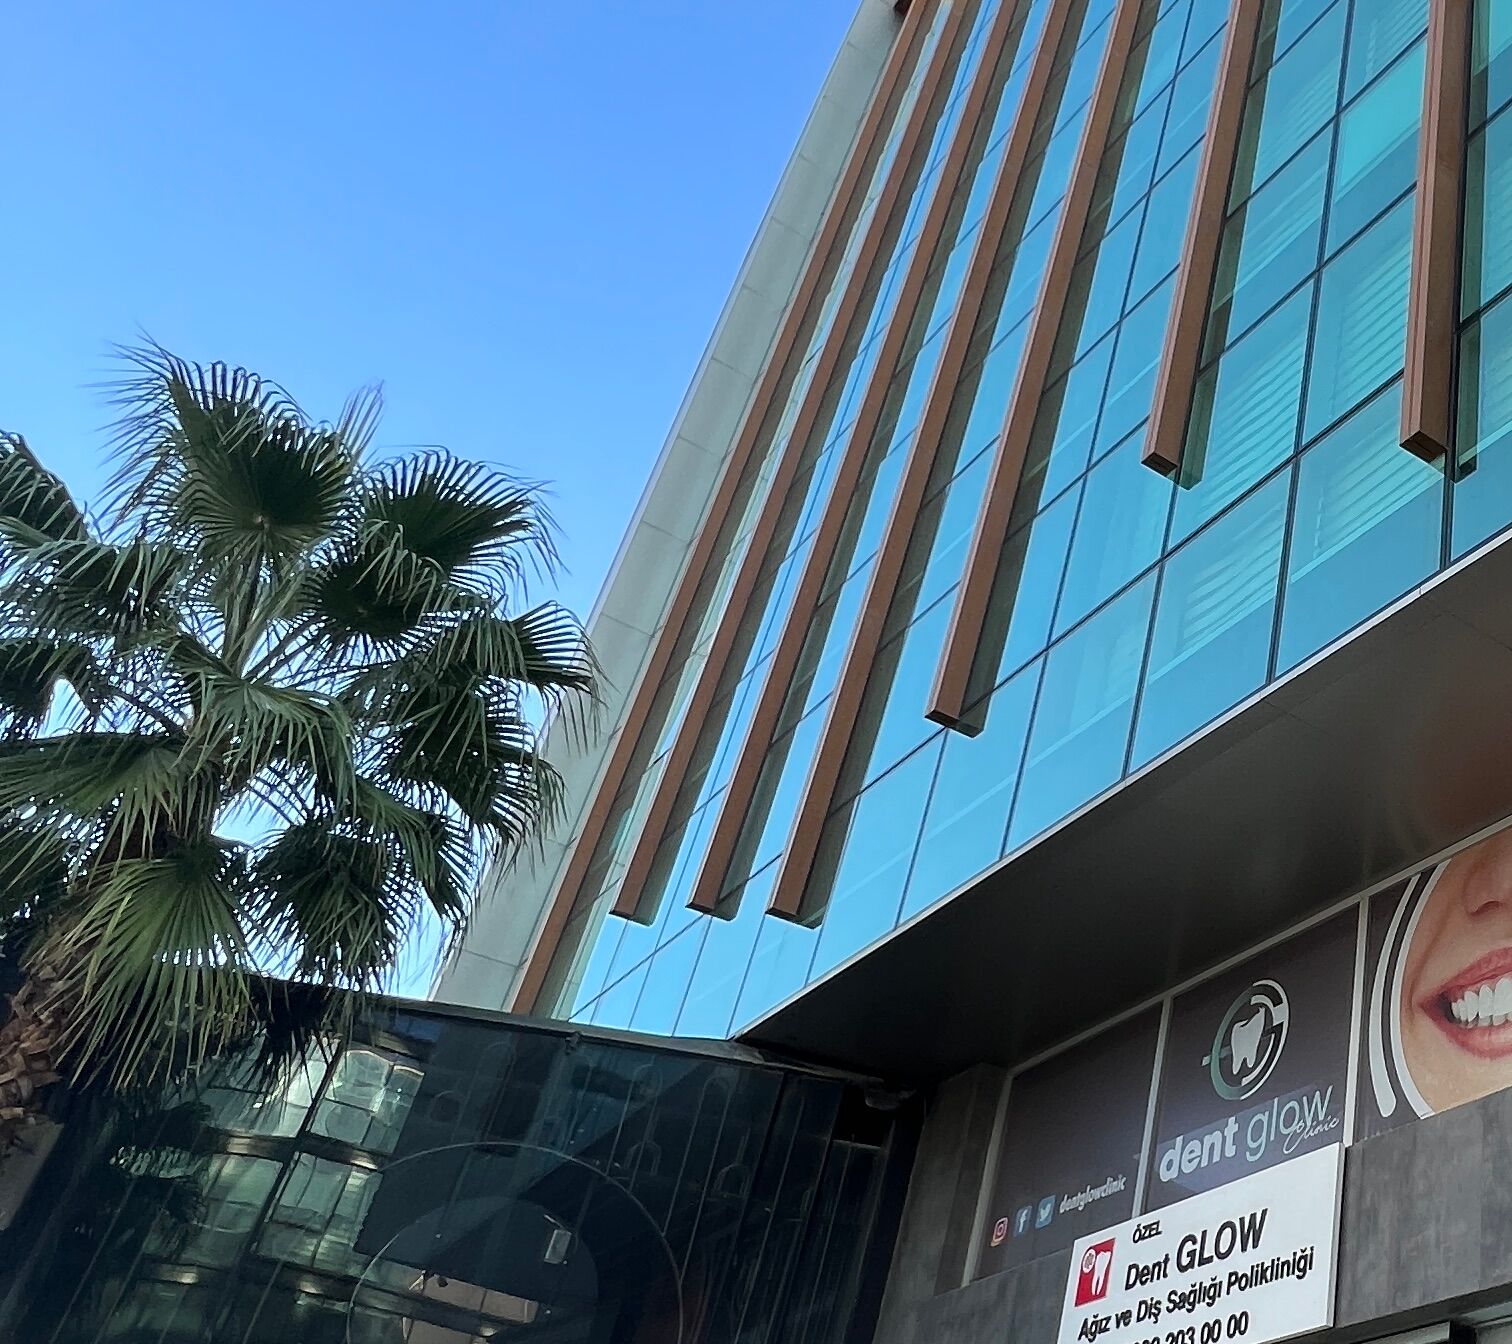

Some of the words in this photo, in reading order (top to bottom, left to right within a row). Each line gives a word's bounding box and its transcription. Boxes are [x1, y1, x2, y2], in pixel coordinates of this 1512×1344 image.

[1159, 1116, 1239, 1182] dent
[1246, 1086, 1333, 1161] glow
[1125, 1253, 1170, 1291] Dent
[1176, 1208, 1268, 1273] GLOW
[1133, 1220, 1162, 1243] ÖZEL
[1077, 1313, 1112, 1343] Ağız
[1115, 1309, 1132, 1329] ve
[1136, 1296, 1162, 1324] Diş
[1166, 1275, 1223, 1313] Sağlığı
[1226, 1246, 1314, 1295] Polikliniği
[1226, 1311, 1249, 1338] 00
